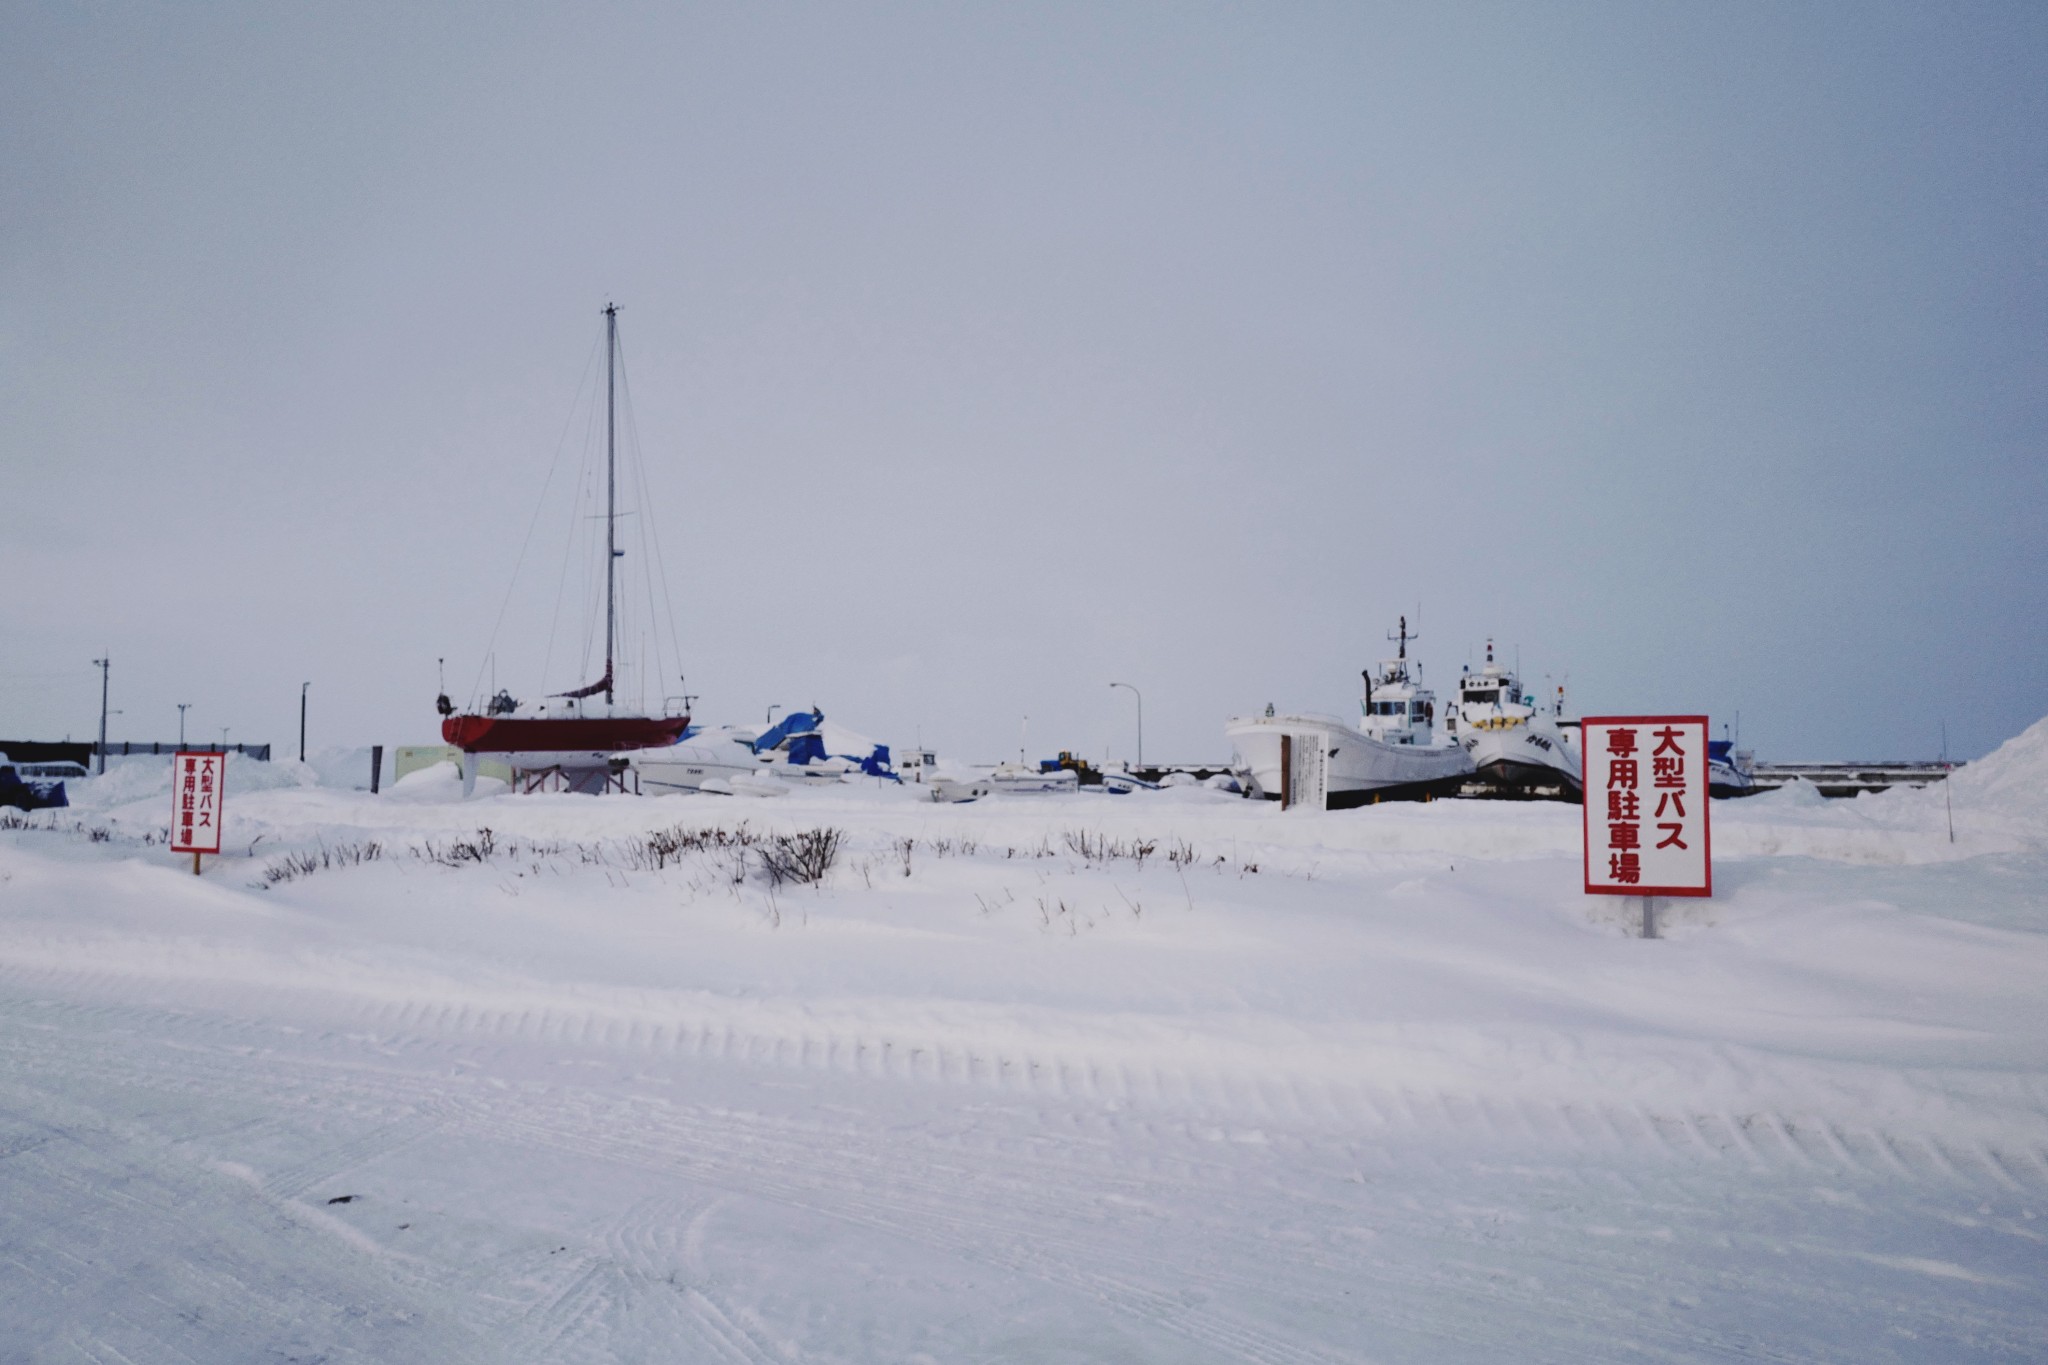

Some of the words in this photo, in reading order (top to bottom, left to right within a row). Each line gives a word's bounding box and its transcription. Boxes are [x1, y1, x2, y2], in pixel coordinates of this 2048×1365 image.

[181, 758, 196, 846] 専用駐車場
[199, 757, 214, 827] 大型バス
[1606, 728, 1641, 884] 専用駐車場
[1652, 725, 1687, 850] 大型バス
